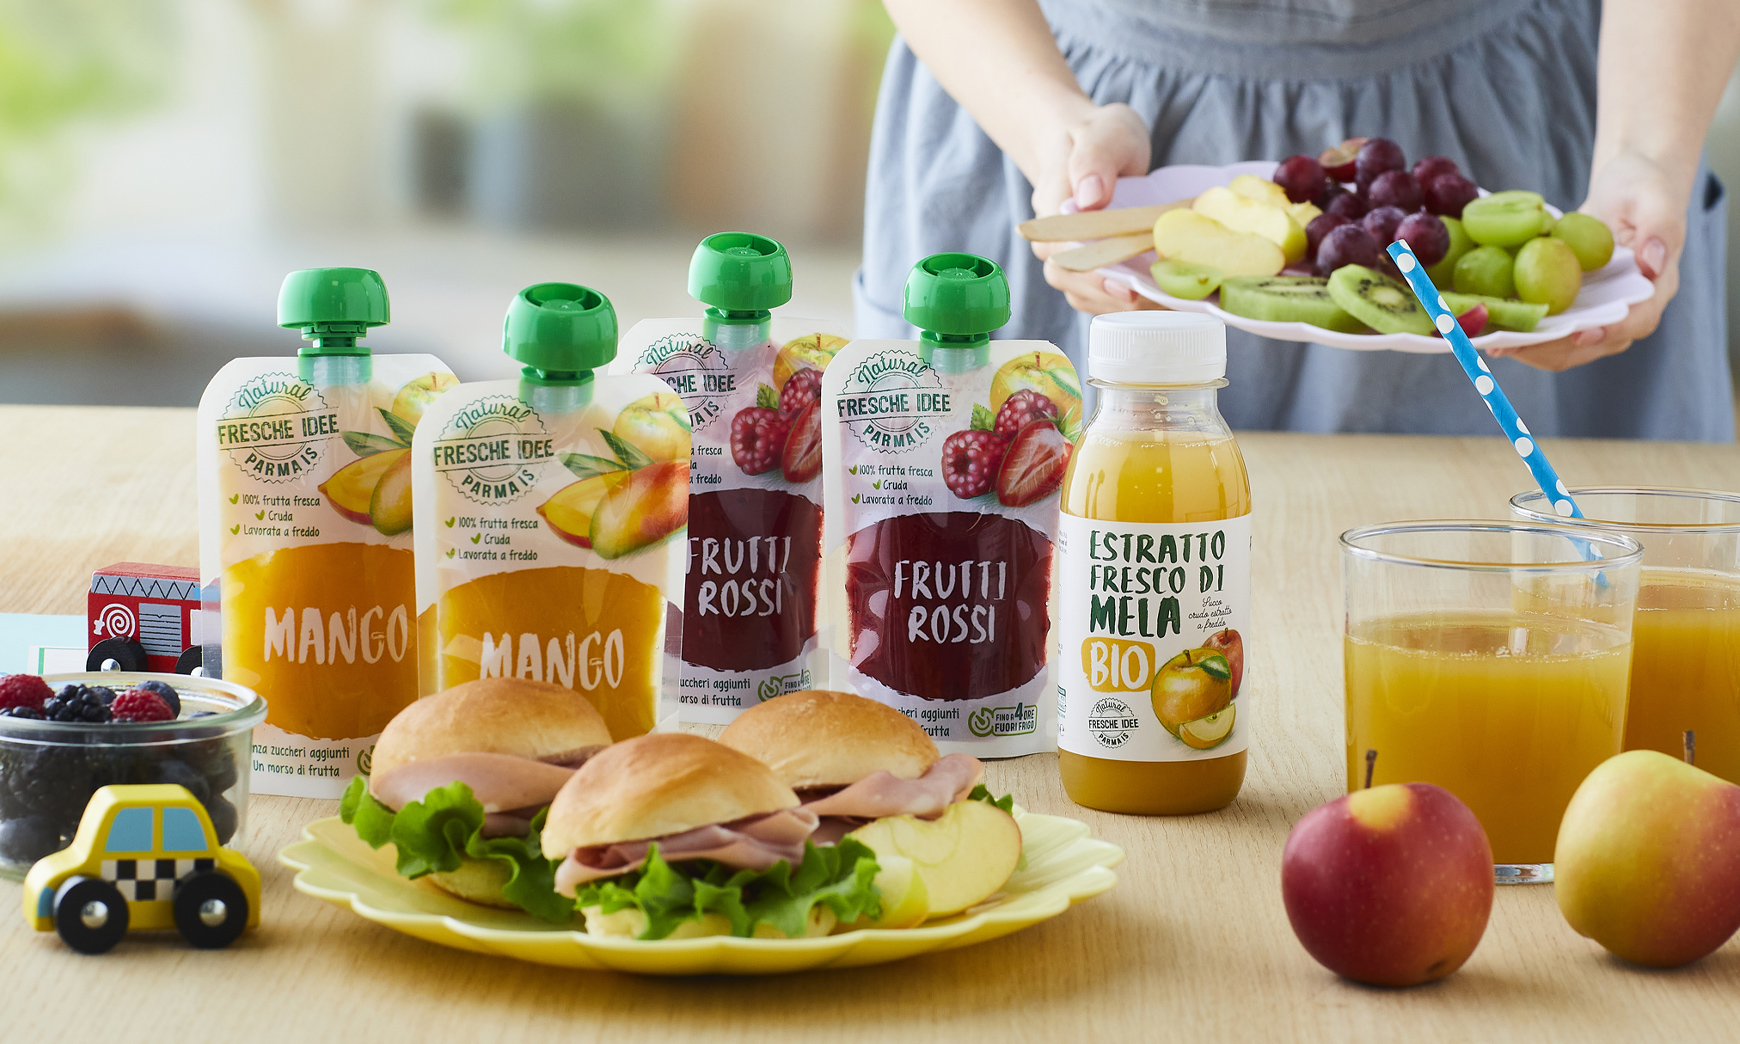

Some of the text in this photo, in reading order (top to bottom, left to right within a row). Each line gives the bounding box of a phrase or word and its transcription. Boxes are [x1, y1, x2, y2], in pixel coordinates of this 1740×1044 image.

[646, 339, 714, 366] Natural
[857, 356, 928, 385] Natural
[703, 374, 737, 393] IDEE
[238, 378, 312, 409] Natural
[837, 393, 952, 417] FRESCHE IDEE
[455, 402, 532, 430] Natural
[217, 413, 340, 445] FRESCHE IDEE
[433, 439, 554, 466] FRESCHE IDEE
[697, 445, 722, 456] fresca
[696, 474, 722, 484] freddo
[859, 464, 933, 477] 100% frutta fresca
[883, 480, 908, 491] Cruda
[242, 494, 320, 507] 100% frutta fresca
[861, 493, 933, 506] Lavorata a freddo
[268, 511, 293, 522] Cruda
[458, 516, 539, 530] 100% frutta fresca
[244, 524, 320, 537] Lavorata a freddo
[484, 533, 511, 545] Cruda
[1090, 530, 1225, 563] ESTRATTO
[459, 550, 538, 561] Lavorata a freddo
[685, 536, 791, 575] FRUTTI
[894, 560, 1007, 600] FRUTTI
[1090, 564, 1224, 594] FRESCO DI
[698, 578, 782, 617] ROSSI
[1202, 596, 1223, 607] Succo
[1090, 594, 1181, 638] MELA
[1188, 605, 1232, 619] crudo estratto
[908, 603, 995, 644] ROSSI
[1203, 617, 1226, 633] freddo
[264, 604, 408, 665] MANGO
[480, 628, 624, 691] MANGO
[1090, 640, 1149, 690] BIO
[680, 677, 709, 689] uccheri
[713, 679, 751, 692] aggiunti
[679, 694, 741, 706] orso di frutta
[1096, 700, 1127, 714] Natural
[921, 707, 960, 722] aggiunti
[996, 714, 1009, 722] FINO
[1015, 702, 1024, 720] 4
[995, 720, 1034, 733] FUORI FRIGO
[1088, 719, 1139, 729] FRESCHE IDEE
[252, 744, 350, 761] nza zuccheri aggiunti
[253, 760, 340, 777] Un morso di frutta
